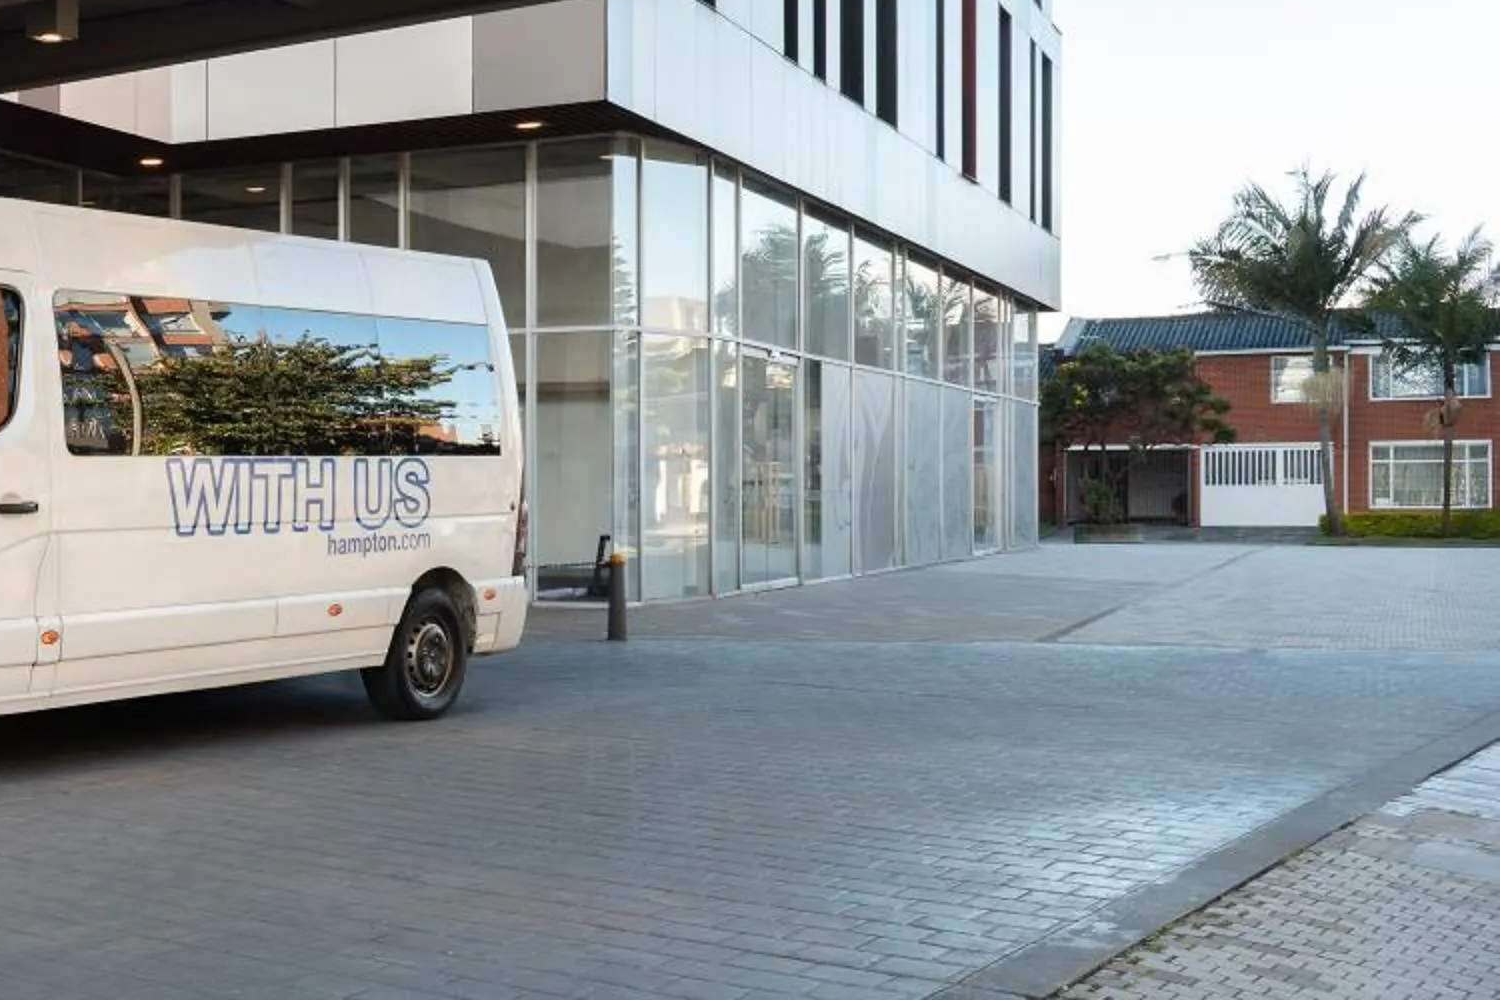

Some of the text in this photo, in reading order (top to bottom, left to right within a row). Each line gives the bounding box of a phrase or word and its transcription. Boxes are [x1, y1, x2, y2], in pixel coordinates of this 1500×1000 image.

[165, 457, 431, 537] WITH US
[326, 531, 432, 558] hampton.com
